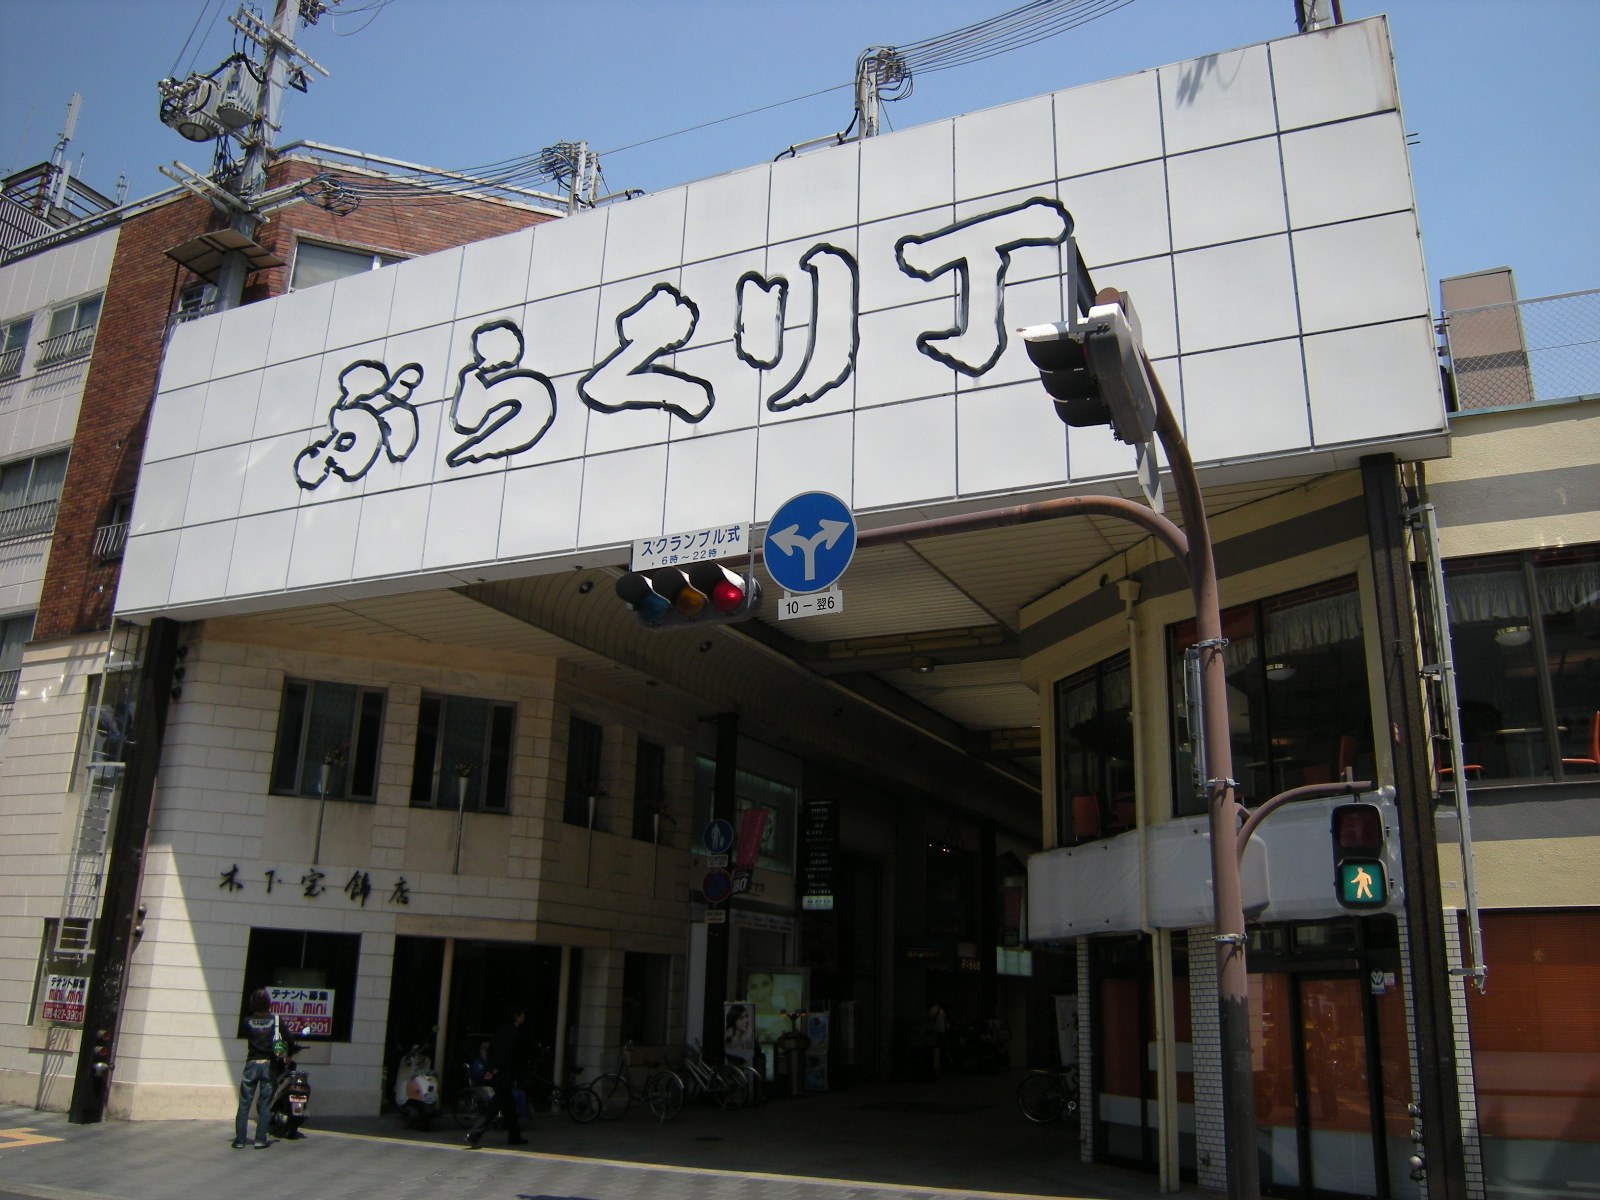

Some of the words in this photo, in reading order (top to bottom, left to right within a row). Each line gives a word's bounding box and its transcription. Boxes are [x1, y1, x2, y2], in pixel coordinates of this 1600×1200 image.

[293, 196, 1074, 491] ぶらくり丁
[641, 525, 741, 557] スクランブル式
[303, 1002, 327, 1015] mini
